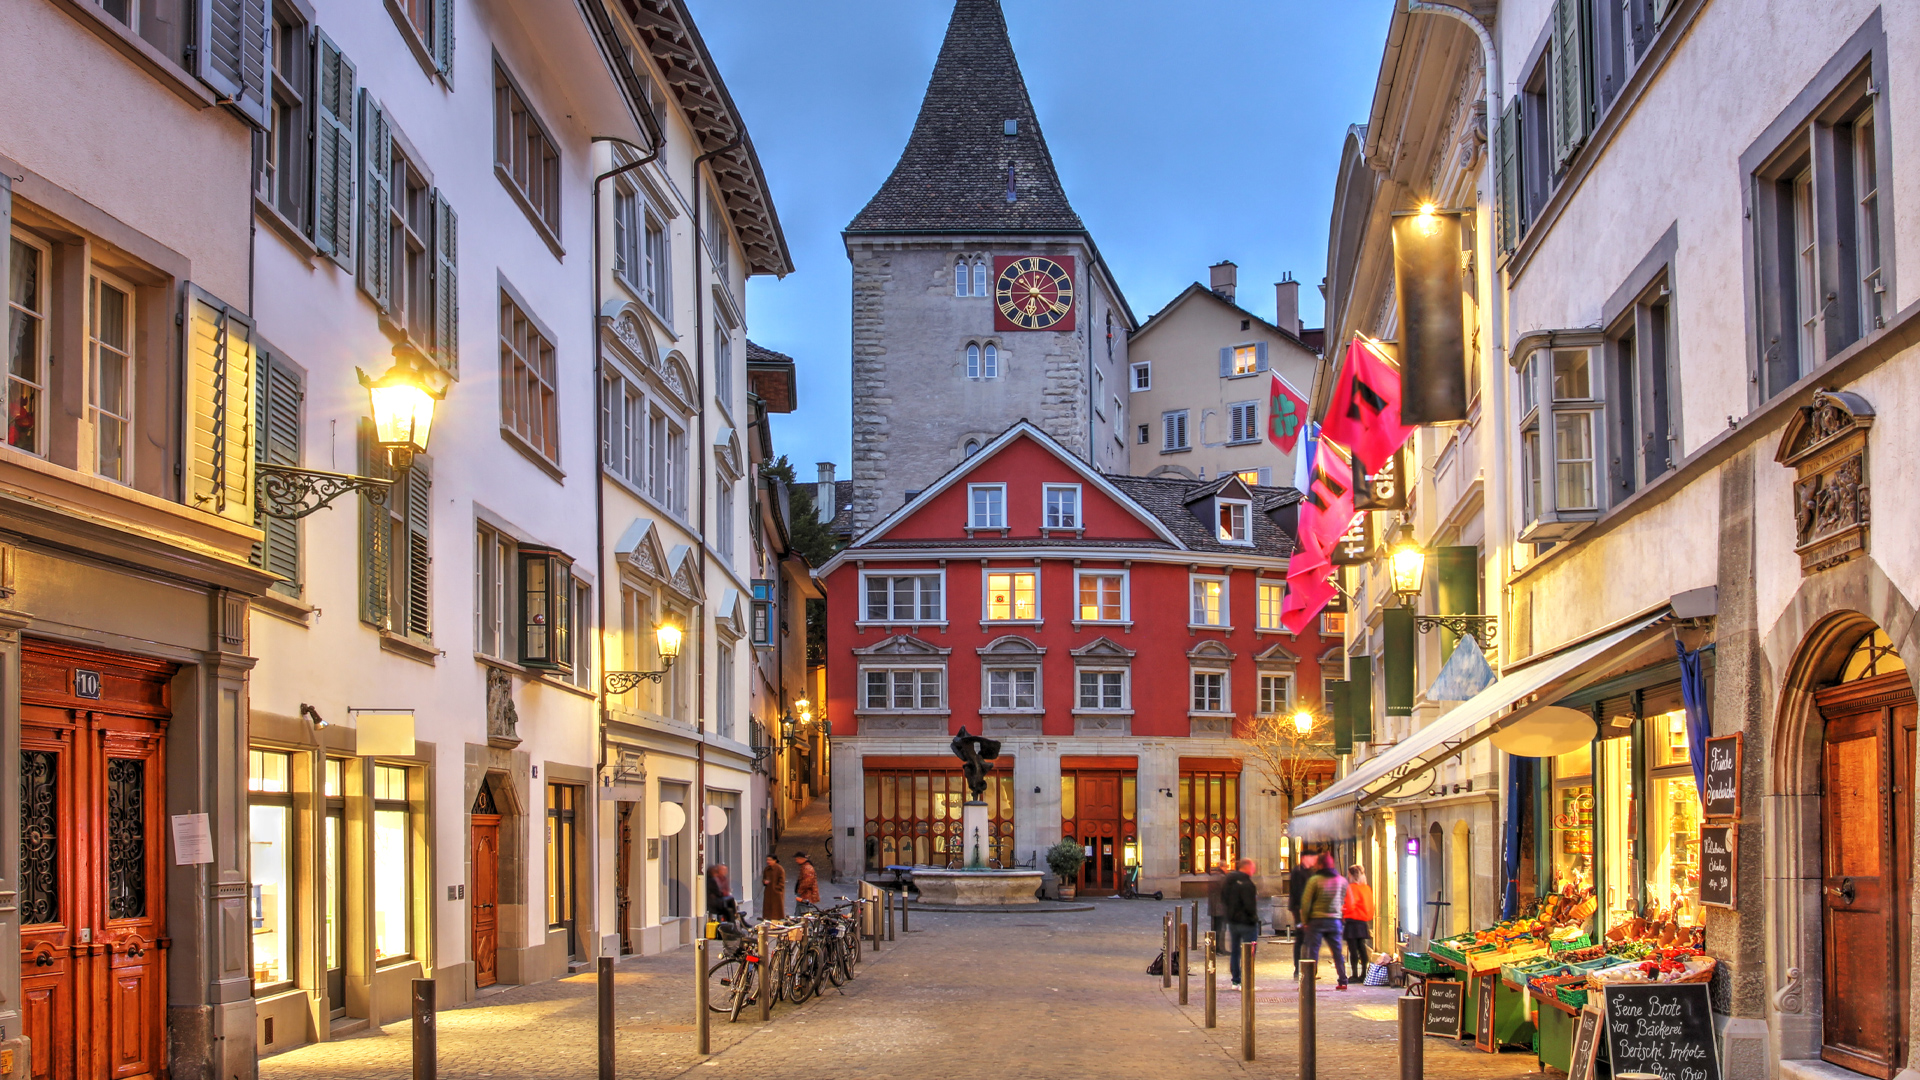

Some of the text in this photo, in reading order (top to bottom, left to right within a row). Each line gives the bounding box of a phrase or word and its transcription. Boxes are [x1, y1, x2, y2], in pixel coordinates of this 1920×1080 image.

[81, 674, 97, 695] 10
[1612, 993, 1681, 1017] Feine Brote
[1611, 1020, 1629, 1035] von
[1635, 1018, 1683, 1040] Bäckerei
